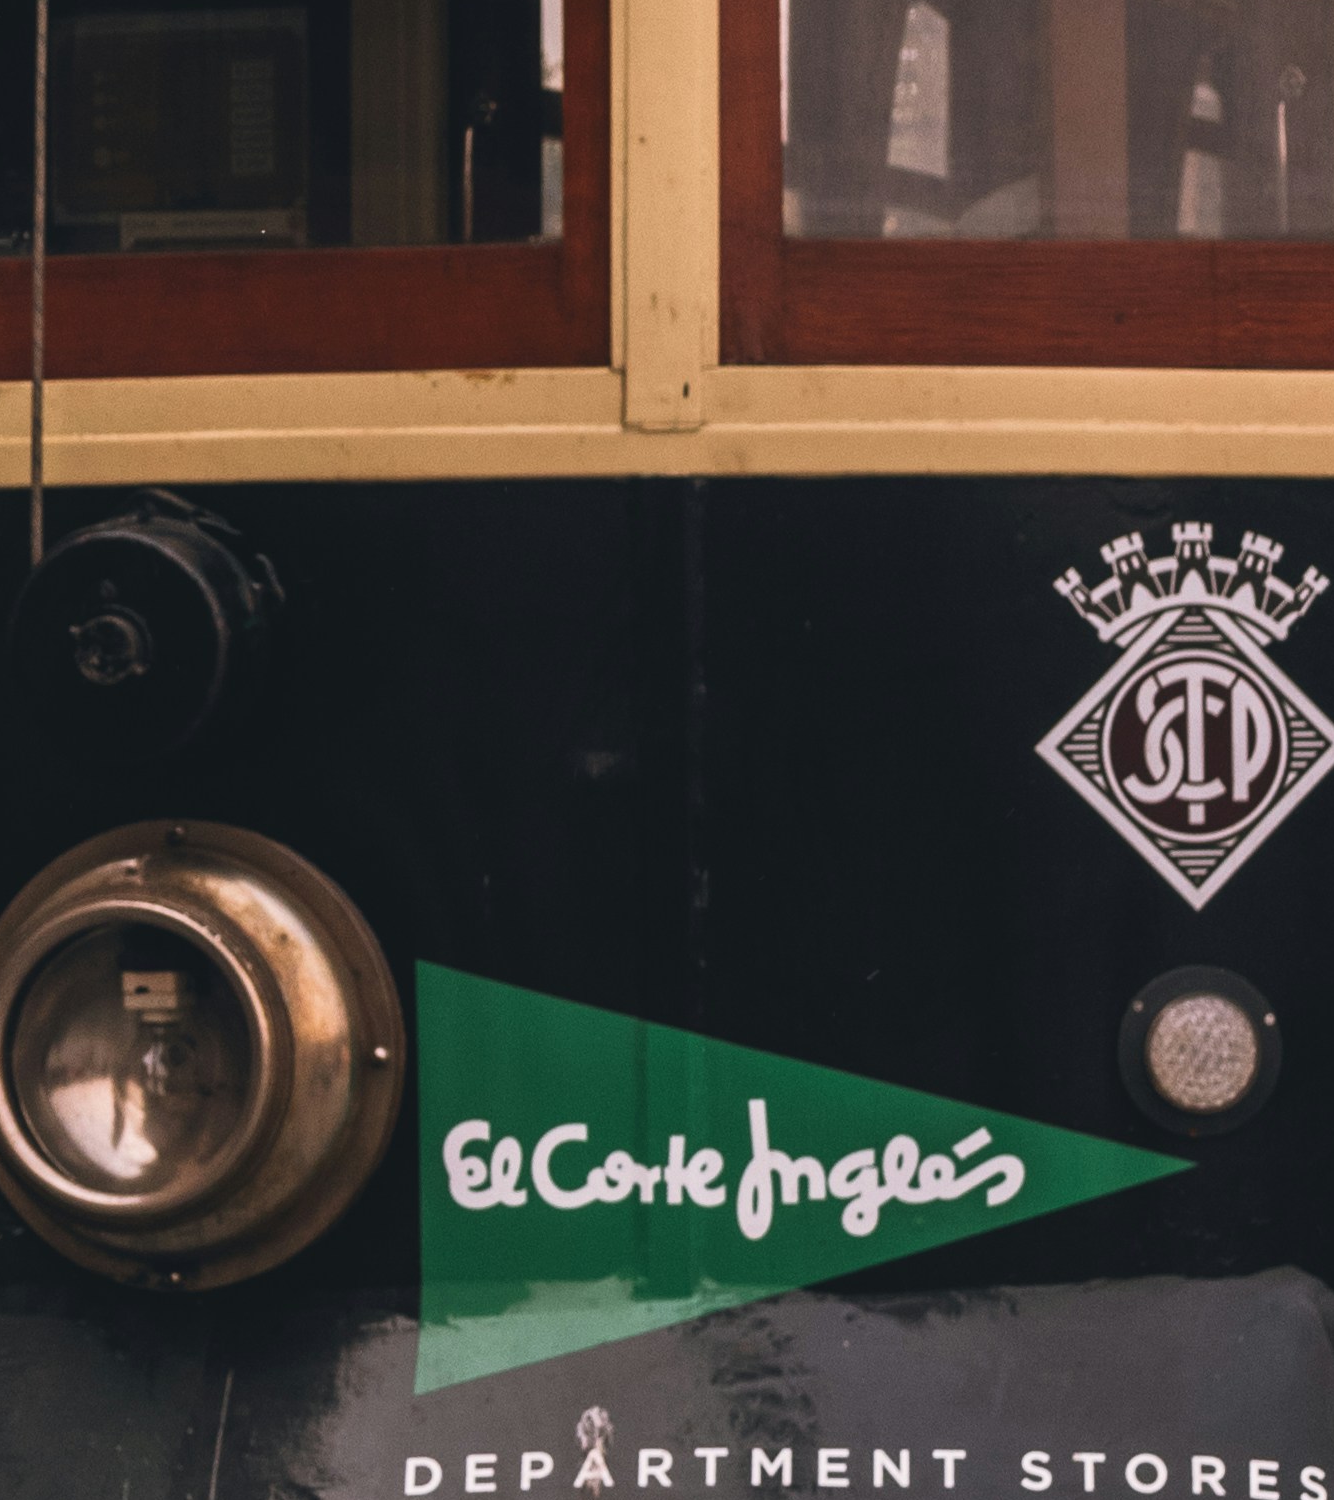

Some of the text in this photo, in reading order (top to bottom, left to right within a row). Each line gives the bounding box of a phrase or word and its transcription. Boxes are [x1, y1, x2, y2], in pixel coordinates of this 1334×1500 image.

[442, 1098, 1026, 1241] El Corte Inglés
[403, 1446, 967, 1498] DEPARTMENT
